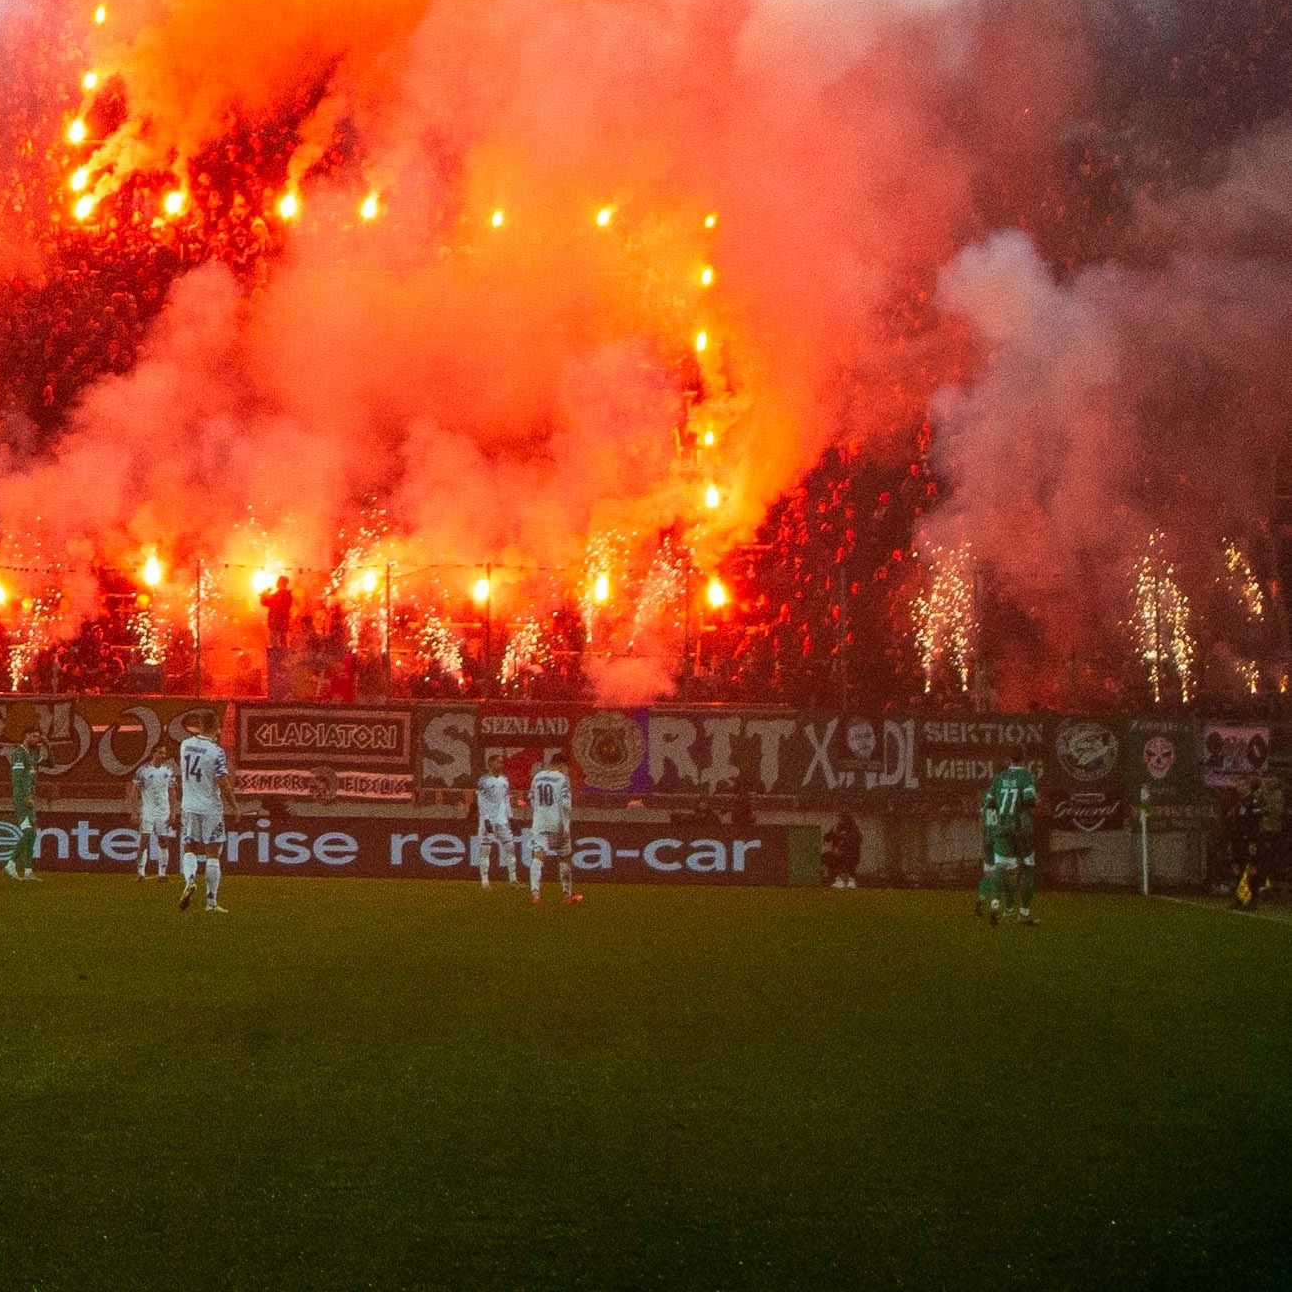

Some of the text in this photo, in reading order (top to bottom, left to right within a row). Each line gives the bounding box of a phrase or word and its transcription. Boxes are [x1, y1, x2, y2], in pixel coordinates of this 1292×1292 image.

[254, 722, 398, 750] GLADIATORI
[923, 721, 1045, 744] SEKTION
[184, 753, 202, 783] 14
[537, 783, 554, 807] 10
[998, 788, 1019, 815] 77
